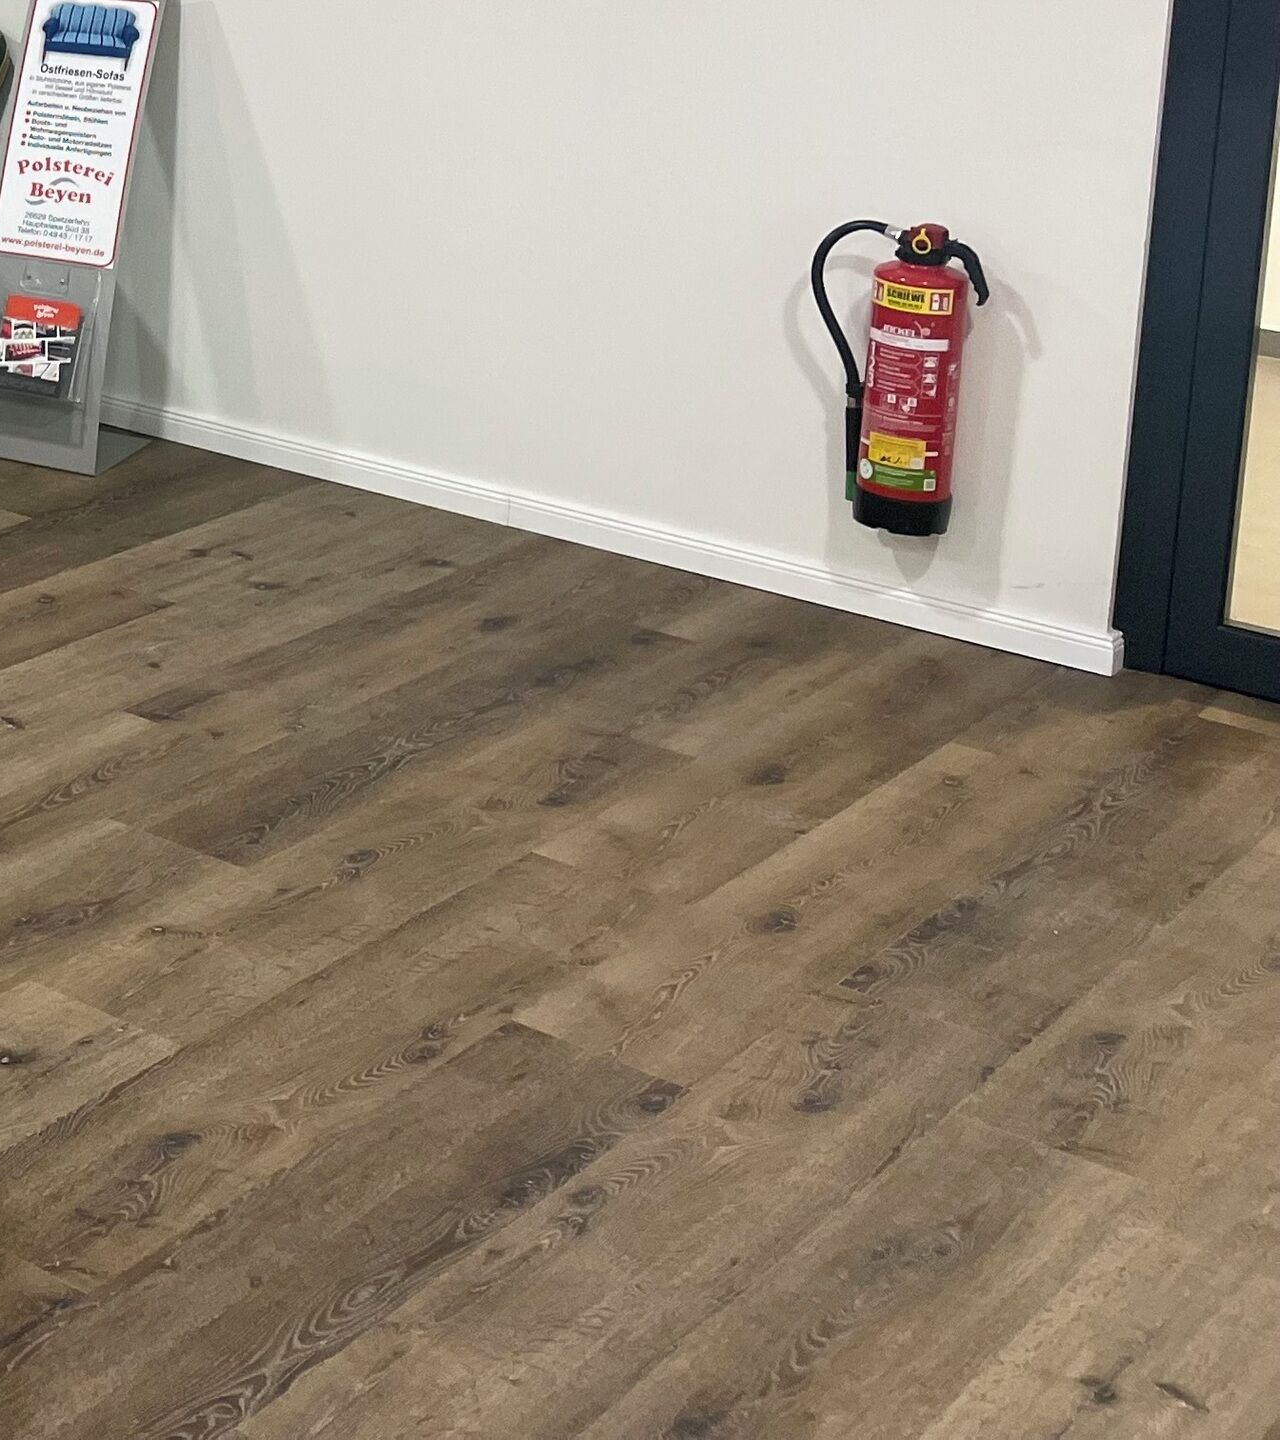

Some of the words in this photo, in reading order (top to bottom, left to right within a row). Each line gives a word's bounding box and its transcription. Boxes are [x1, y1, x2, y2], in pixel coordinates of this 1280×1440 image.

[40, 63, 125, 81] Ostfriesen-Sofas
[17, 157, 115, 187] Polsterei
[30, 182, 91, 204] Beyen
[1, 236, 104, 257] www.polsterei-beyen.de
